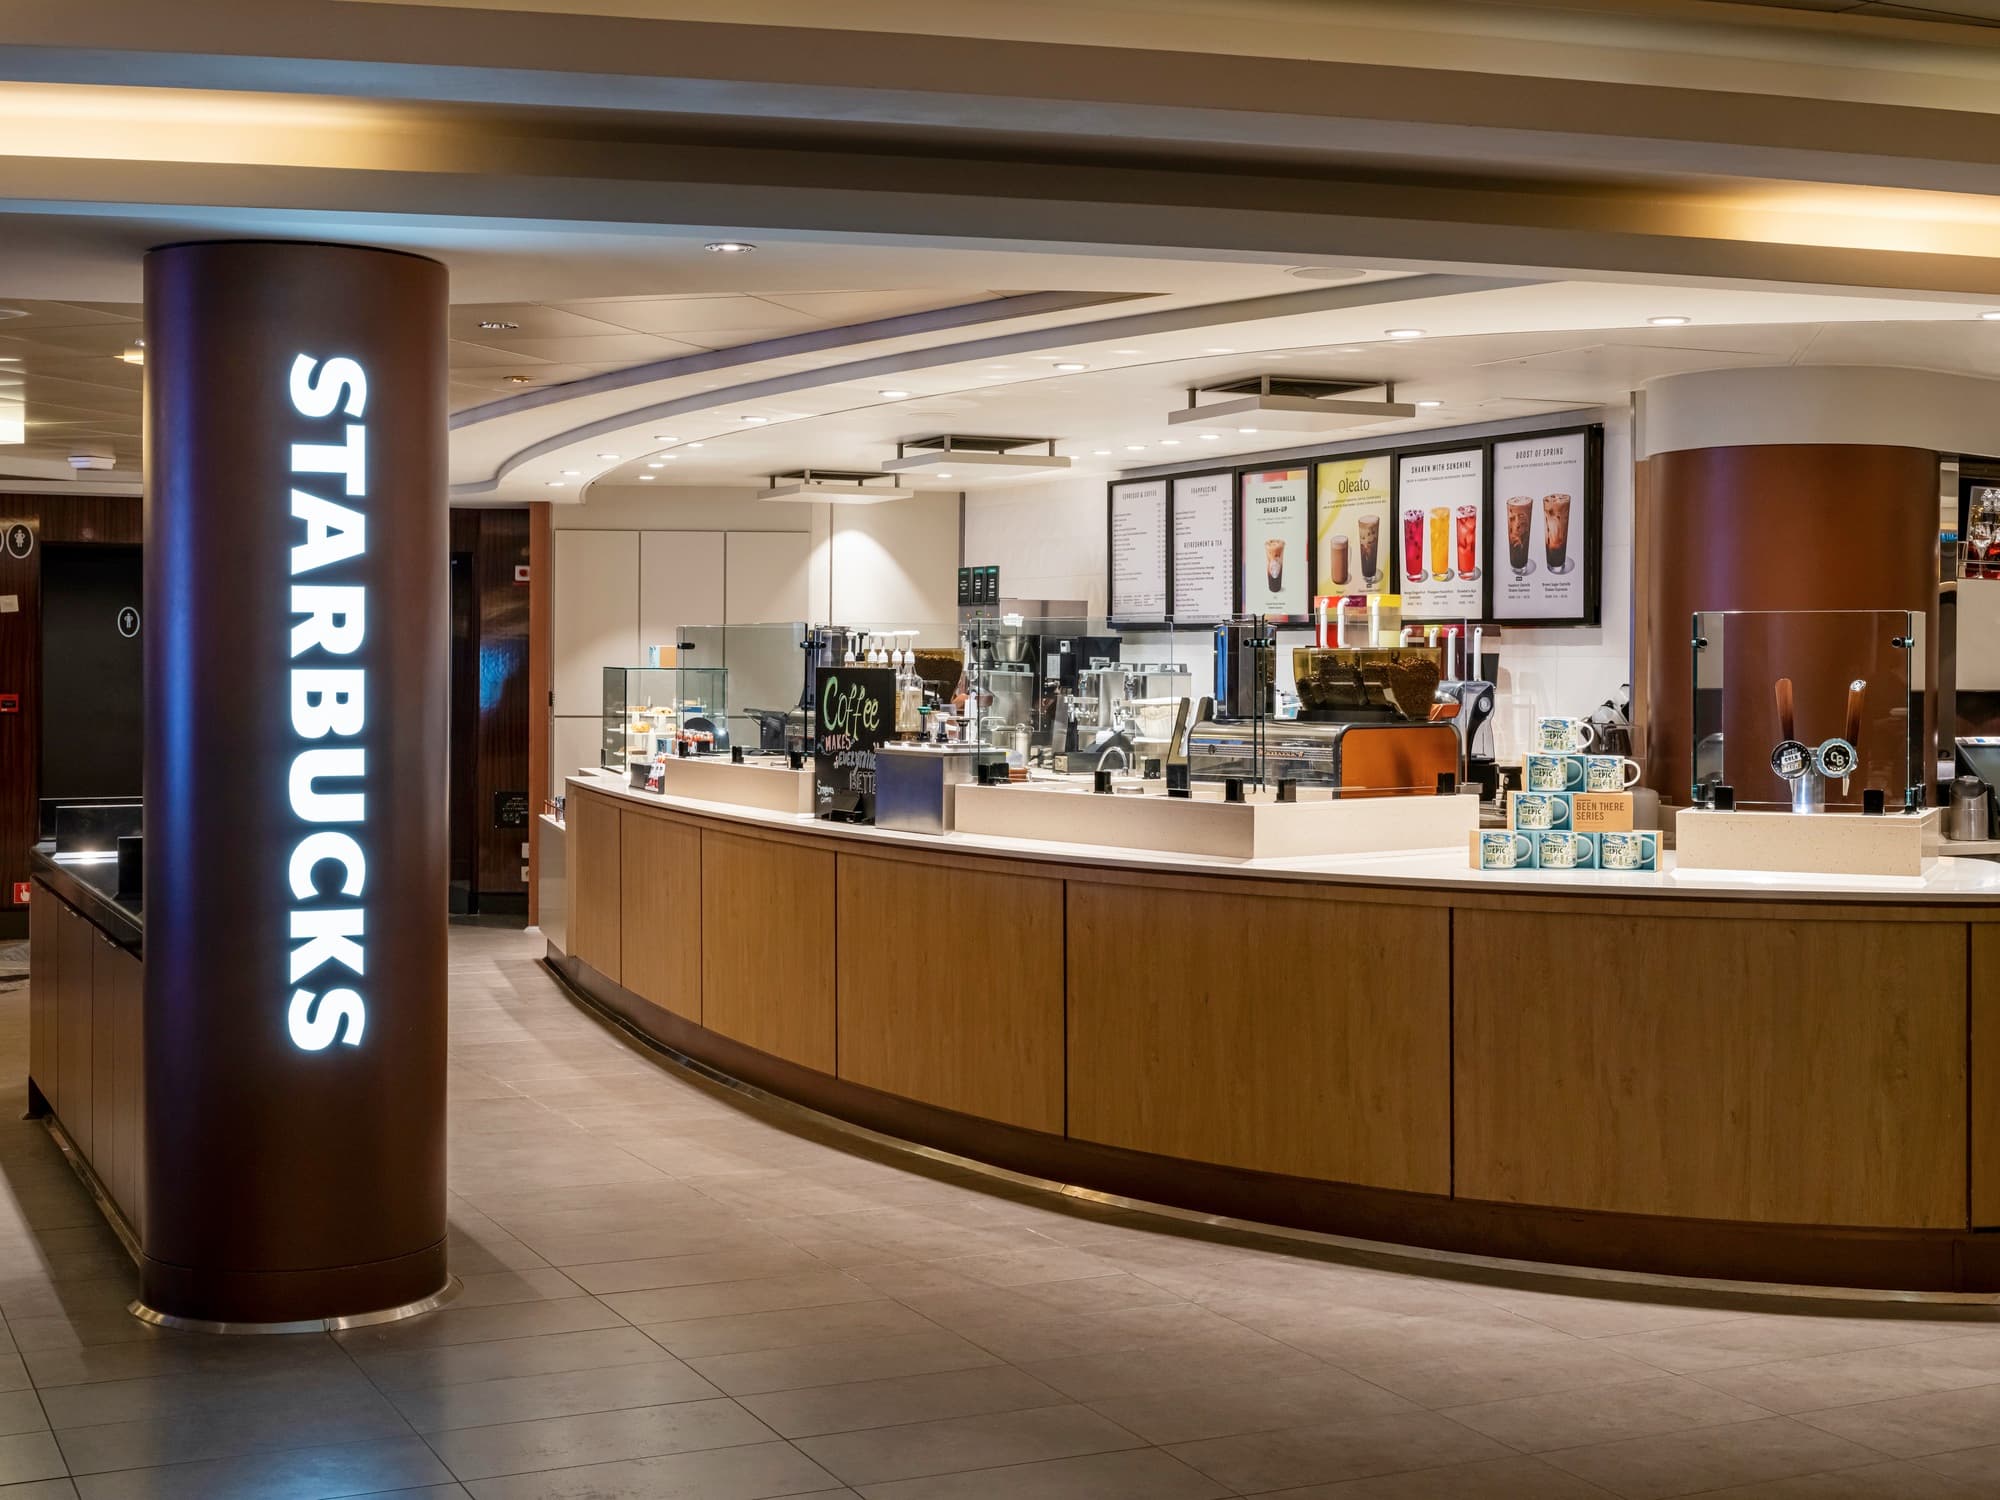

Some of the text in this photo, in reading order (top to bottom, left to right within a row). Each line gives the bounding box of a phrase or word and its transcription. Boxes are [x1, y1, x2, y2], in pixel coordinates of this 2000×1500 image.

[1543, 447, 1563, 456] SPRING
[1411, 460, 1471, 473] SHAKEN WITH SUNSHINE
[1338, 477, 1370, 494] Oleato
[1255, 496, 1276, 504] TOASTED
[1263, 506, 1287, 514] SHAKE-UP
[288, 353, 368, 1051] STARBUCKS
[823, 676, 880, 741] Coffee
[825, 733, 852, 752] MAKES
[1576, 802, 1625, 811] BEEN THERE
[1576, 812, 1604, 821] SERIES
